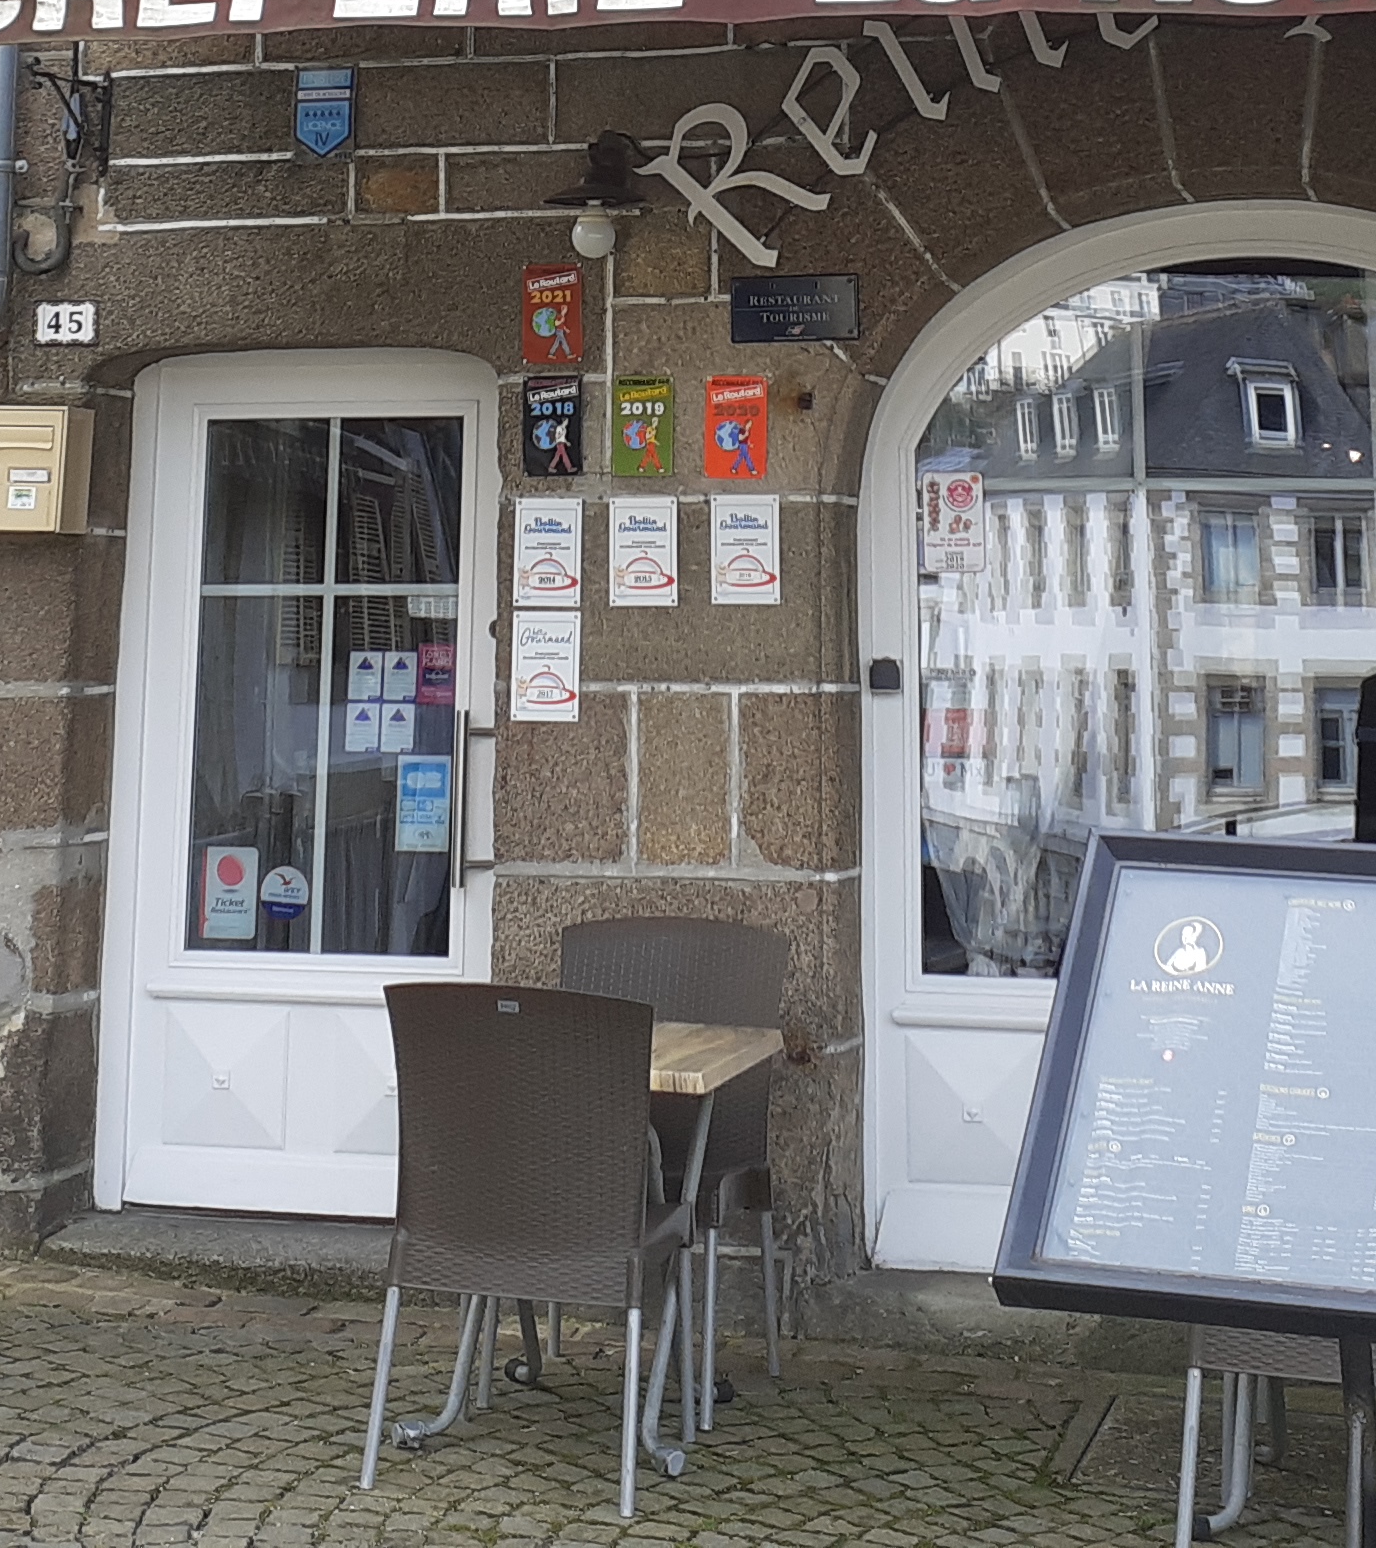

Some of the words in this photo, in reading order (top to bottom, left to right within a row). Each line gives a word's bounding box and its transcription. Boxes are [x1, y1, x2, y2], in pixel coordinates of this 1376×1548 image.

[528, 280, 539, 290] Le
[539, 273, 575, 288] Routard
[530, 290, 572, 303] 2021
[749, 293, 839, 307] RESTAURANT
[46, 311, 84, 335] 45
[760, 311, 830, 323] TOURISME
[529, 392, 539, 401] Le
[539, 386, 577, 399] Routard
[619, 392, 630, 401] Le
[712, 393, 724, 402] Le
[724, 387, 761, 400] Routard
[530, 402, 574, 415] 2018
[620, 402, 665, 415] 2019
[215, 897, 245, 908] Ticket
[1130, 979, 1149, 992] LA
[1151, 978, 1191, 993] REINE
[1193, 980, 1235, 996] ANNE
